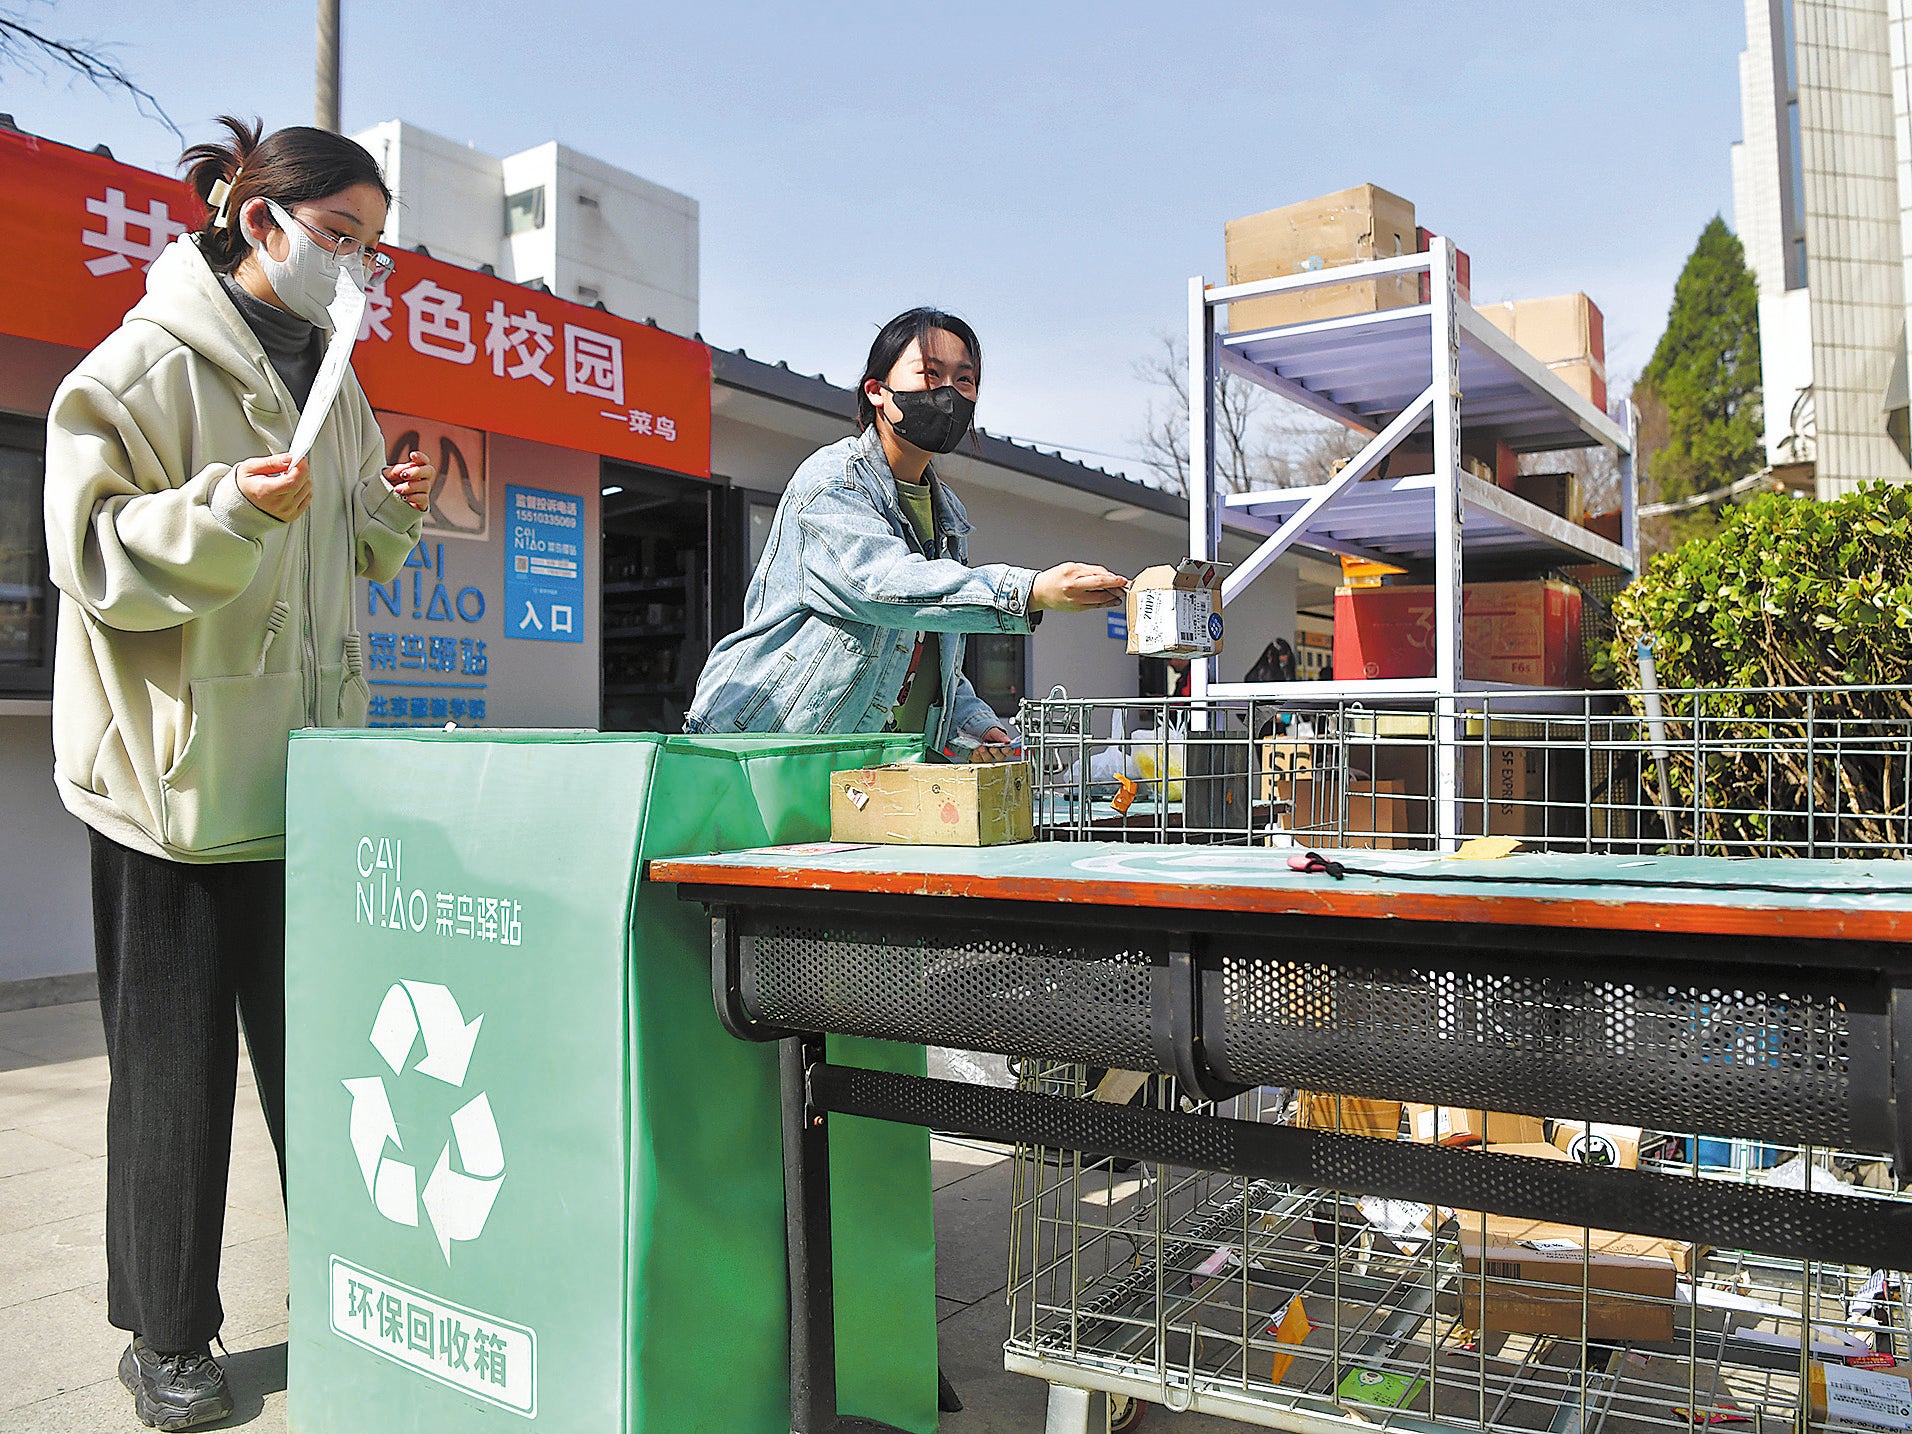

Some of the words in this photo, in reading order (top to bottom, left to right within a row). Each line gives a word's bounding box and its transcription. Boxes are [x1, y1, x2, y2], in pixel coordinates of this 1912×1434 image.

[81, 186, 187, 277] 共
[519, 600, 573, 634] 入口
[368, 630, 488, 676] 菜鸟驿站
[1501, 750, 1514, 765] SF
[435, 891, 523, 946] 菜鸟驿站
[347, 1278, 508, 1388] 环保回收箱
